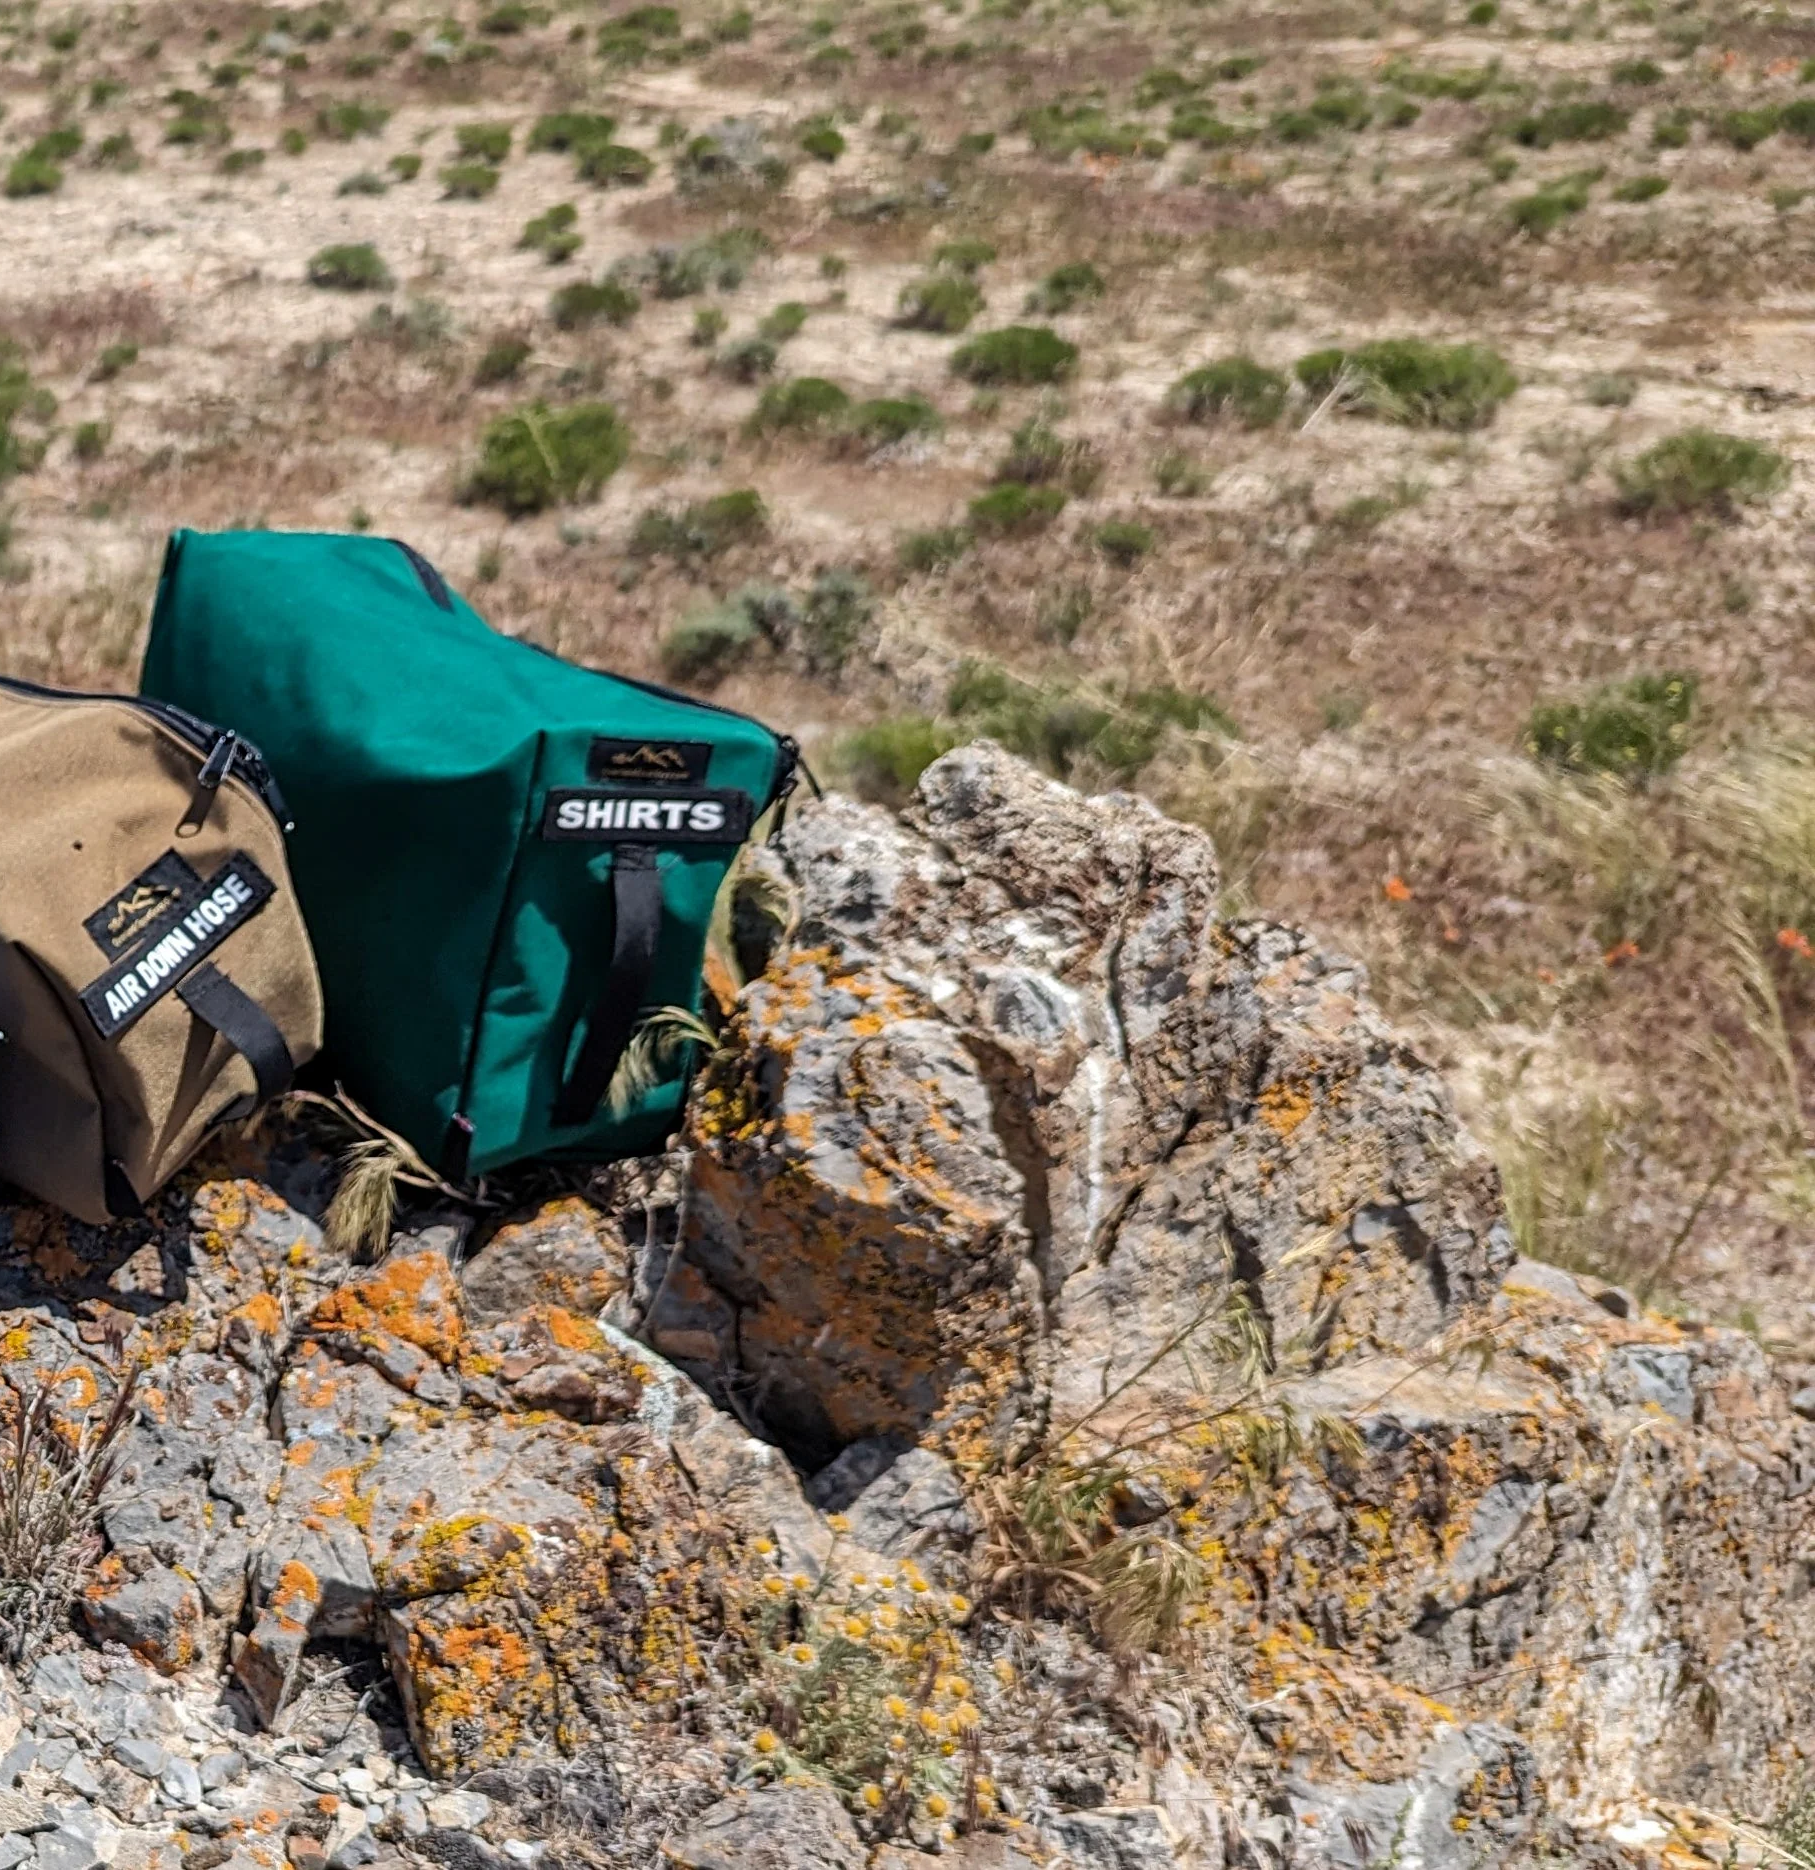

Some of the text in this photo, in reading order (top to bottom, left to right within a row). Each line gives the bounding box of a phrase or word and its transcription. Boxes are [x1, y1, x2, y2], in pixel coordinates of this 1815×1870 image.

[556, 799, 725, 831] SHIRTS
[104, 973, 147, 1021] AIR
[136, 927, 196, 989] DOWN
[183, 873, 253, 940] HOSE
